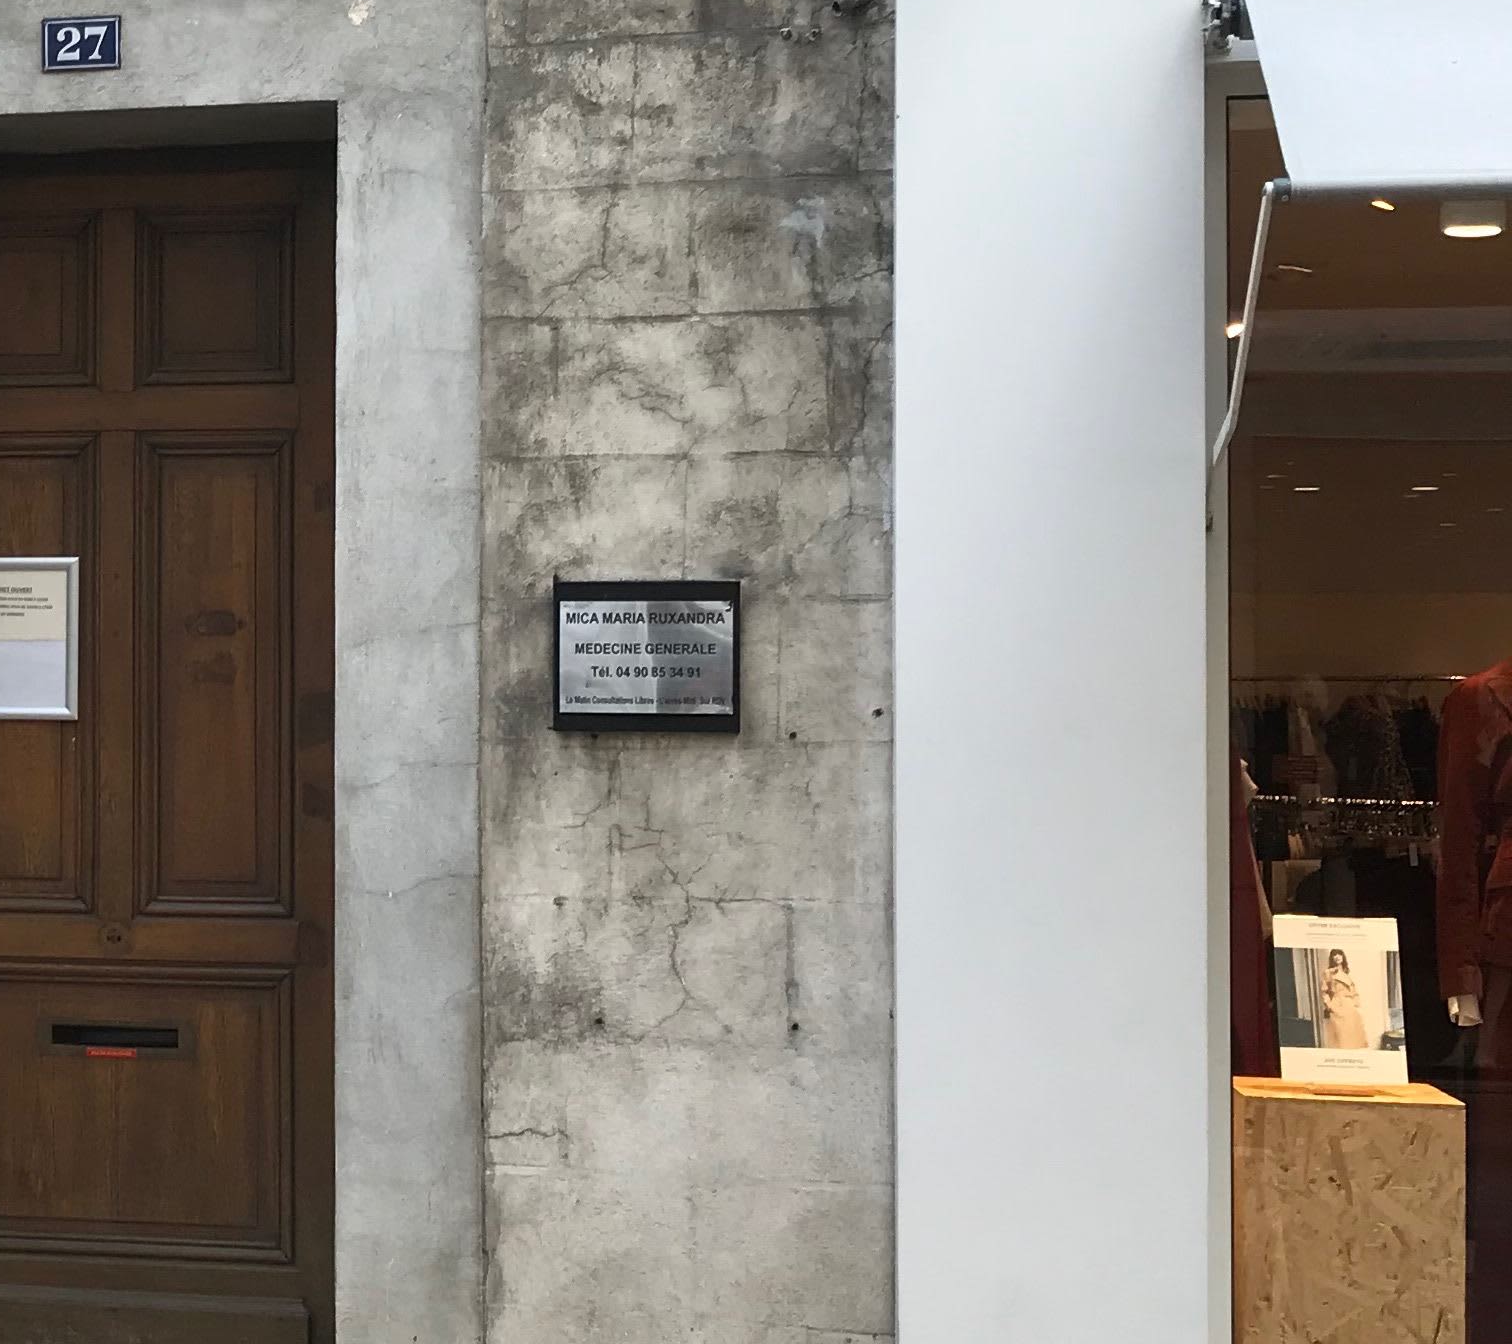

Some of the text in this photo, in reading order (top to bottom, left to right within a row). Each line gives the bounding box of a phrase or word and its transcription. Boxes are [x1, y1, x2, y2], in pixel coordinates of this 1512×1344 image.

[56, 25, 108, 62] 27
[565, 612, 725, 624] MICA MARIA RUXANDRA
[575, 643, 716, 655] MEDECINE GENERALE
[616, 666, 631, 678] 04
[634, 666, 648, 678] 90
[652, 666, 666, 678] 85
[670, 666, 684, 678] 34
[687, 666, 701, 678] 91
